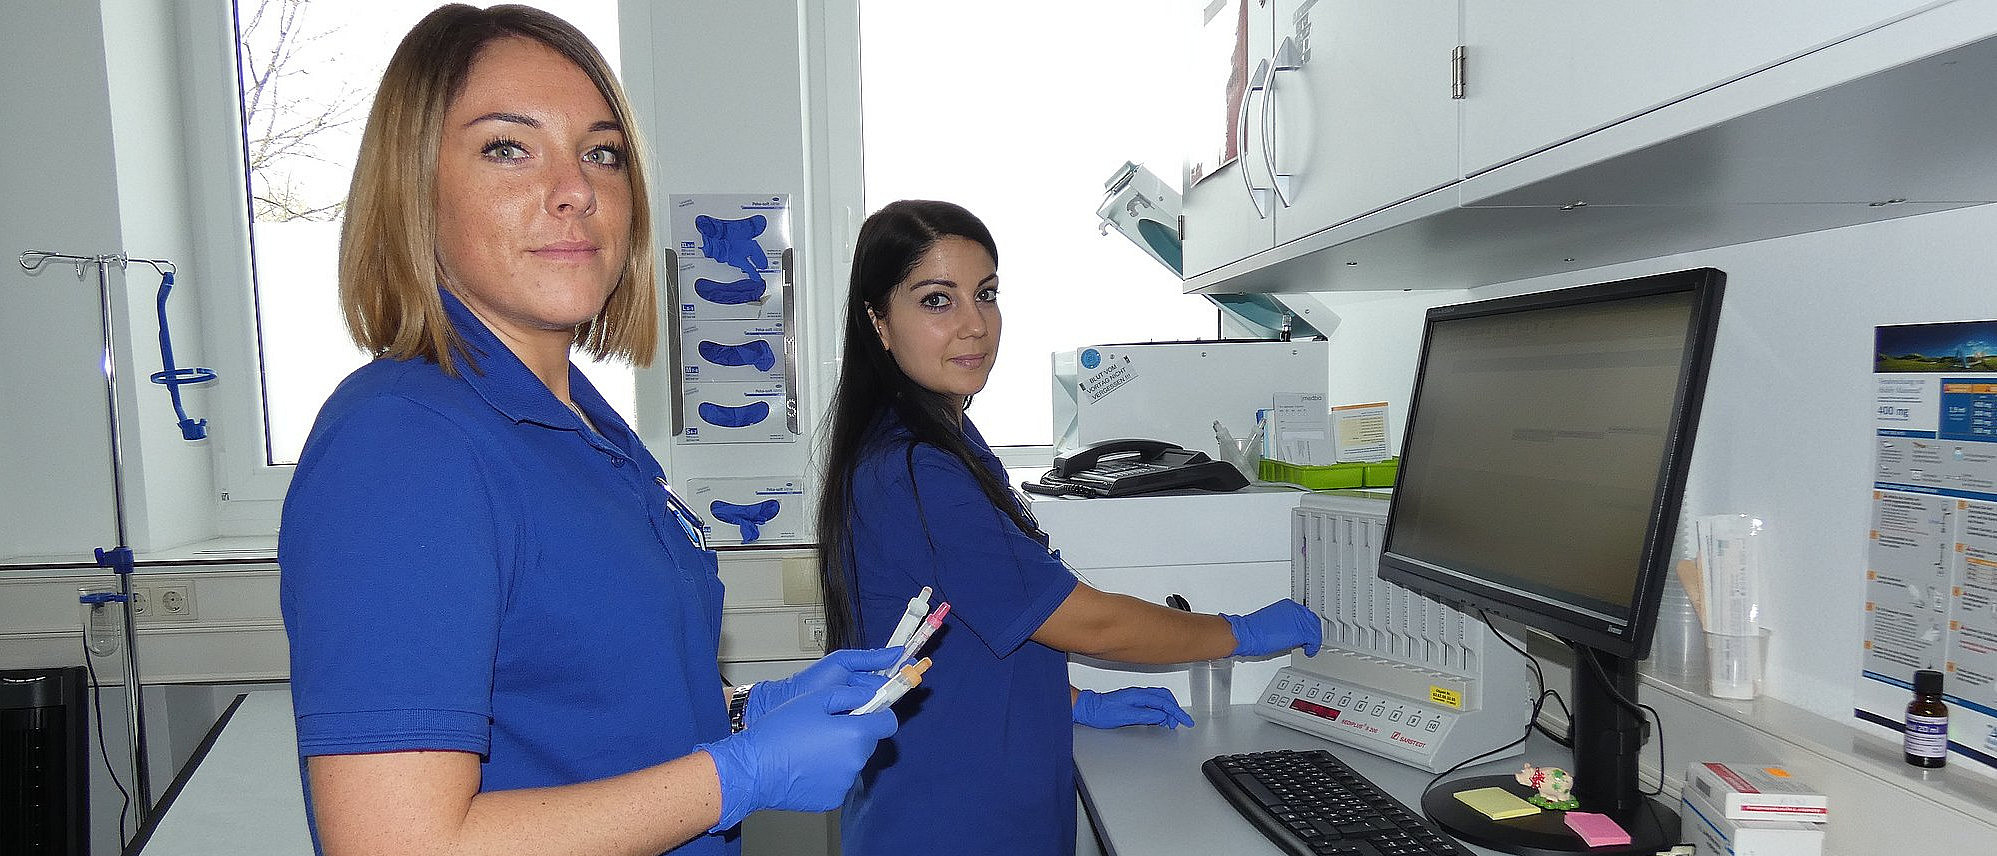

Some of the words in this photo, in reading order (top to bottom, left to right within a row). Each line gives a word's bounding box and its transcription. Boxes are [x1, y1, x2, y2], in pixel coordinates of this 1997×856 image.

[1086, 377, 1110, 394] VORTAG
[1109, 367, 1126, 380] NICHT
[1089, 372, 1104, 384] BLUT
[1103, 364, 1118, 375] VOM
[1092, 376, 1125, 400] VERGESSEN
[786, 398, 797, 418] S
[1877, 406, 1894, 415] 400
[1896, 408, 1909, 418] mg
[1399, 736, 1426, 748] SARSTEDT
